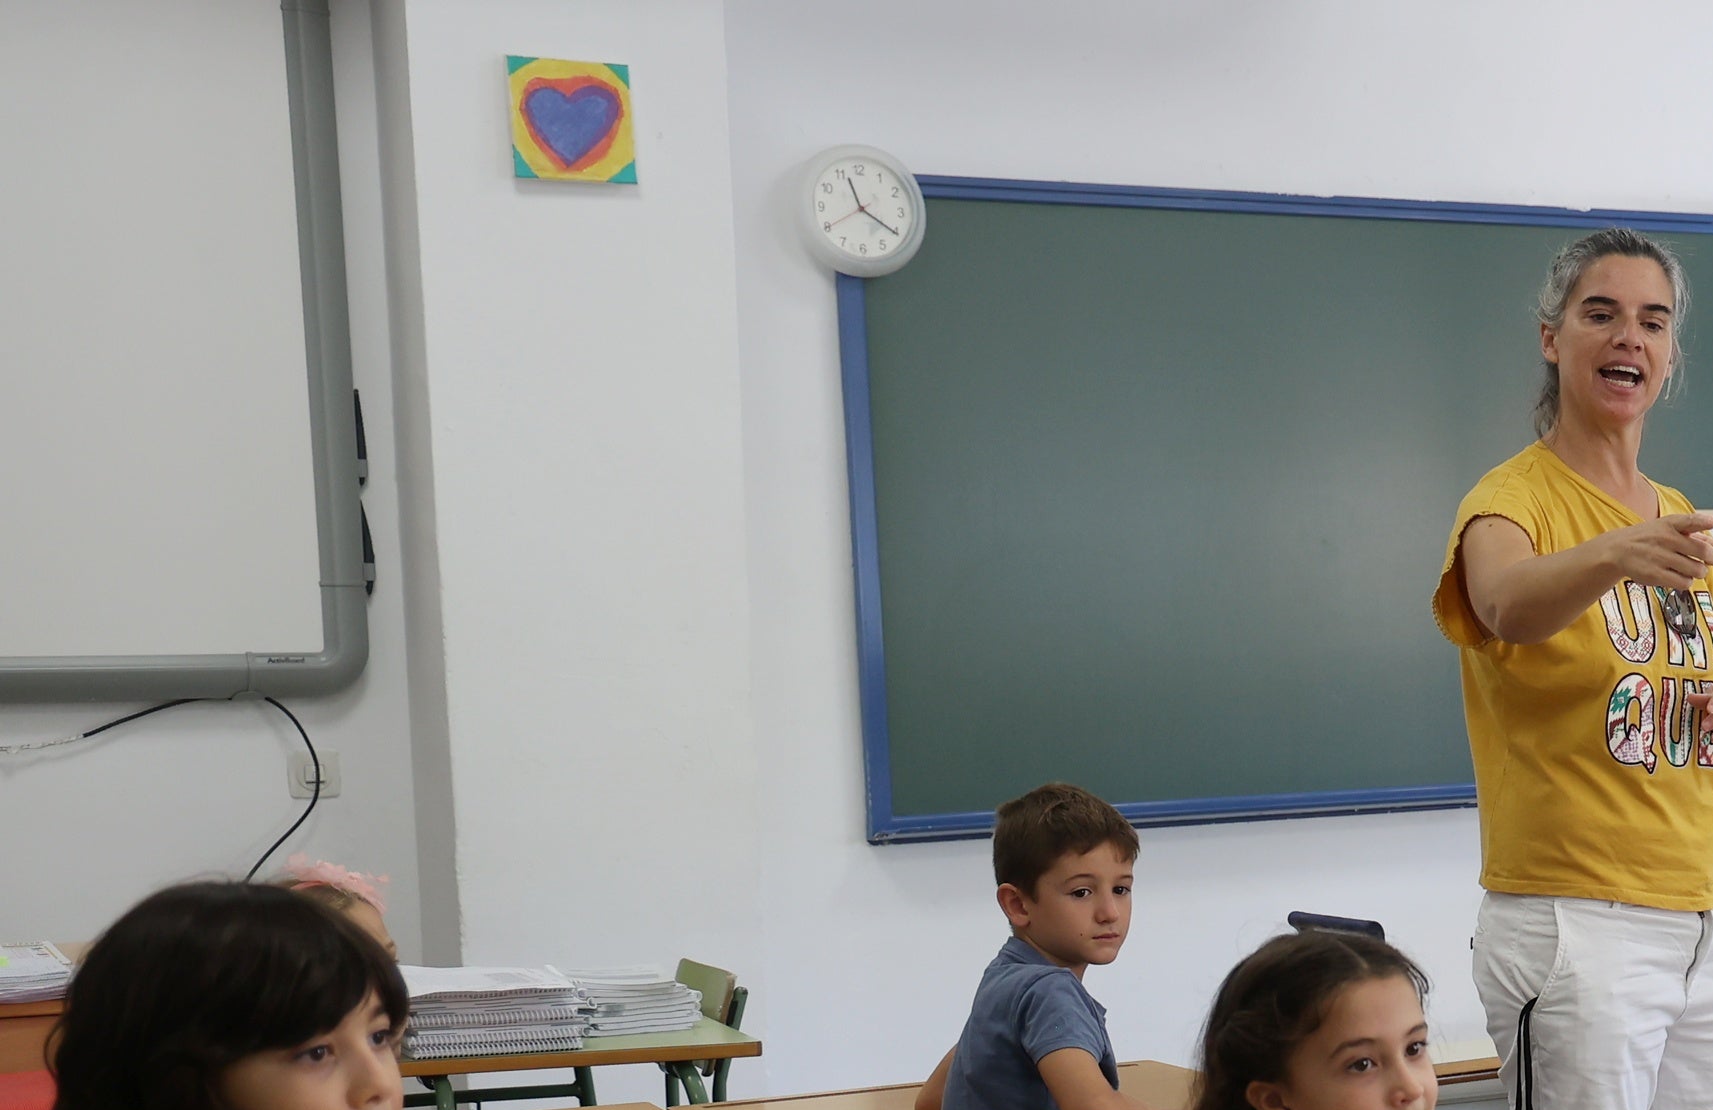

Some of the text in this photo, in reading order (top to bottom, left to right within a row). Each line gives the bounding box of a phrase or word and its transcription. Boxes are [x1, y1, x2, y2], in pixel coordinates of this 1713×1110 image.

[835, 169, 846, 180] 11
[852, 164, 865, 176] 12
[821, 183, 833, 194] 10
[891, 187, 899, 198] 2
[818, 201, 825, 212] 9
[897, 207, 905, 218] 3
[824, 221, 831, 233] 8
[840, 237, 847, 247] 7
[879, 240, 887, 250] 5
[859, 244, 867, 255] 6
